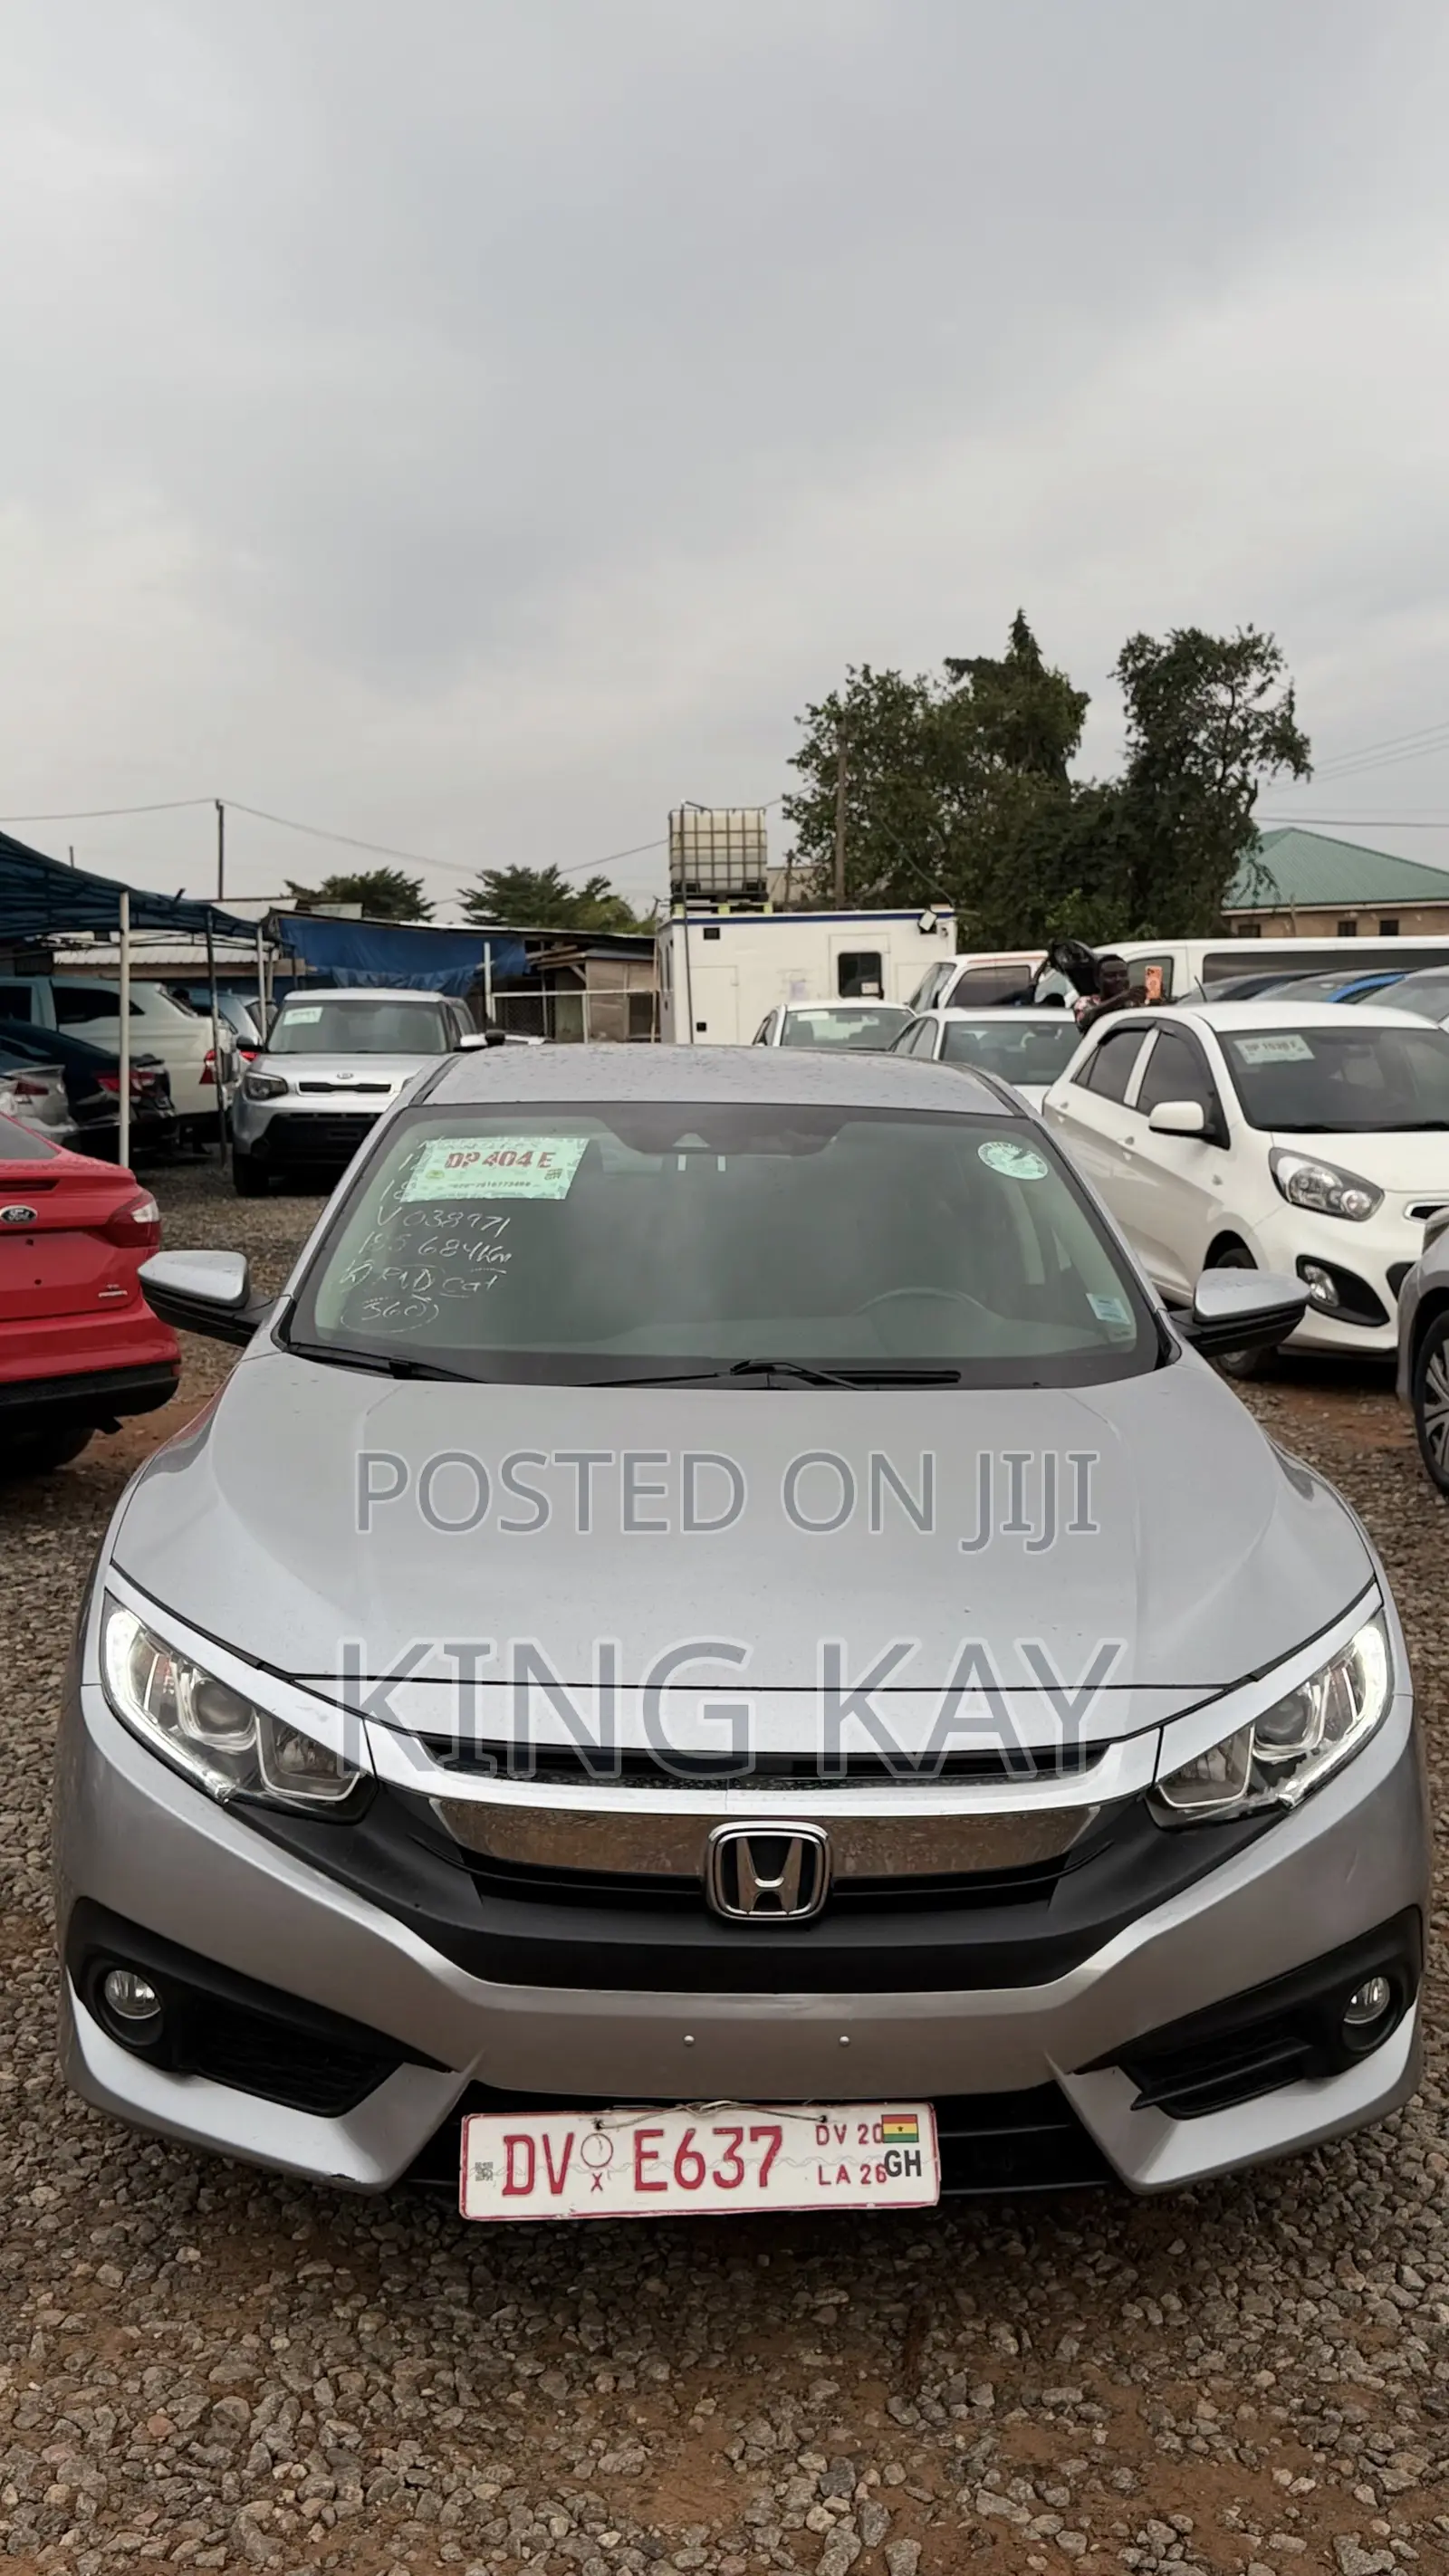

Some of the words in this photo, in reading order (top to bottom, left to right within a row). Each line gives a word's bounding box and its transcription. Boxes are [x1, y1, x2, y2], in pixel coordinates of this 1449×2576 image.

[445, 1151, 481, 1169] DP
[482, 1151, 534, 1167] 404
[537, 1152, 556, 1169] E
[816, 2123, 848, 2146] DV
[502, 2132, 575, 2197] DV
[634, 2125, 782, 2192] E637
[884, 2150, 922, 2178] GH
[819, 2164, 851, 2185] LA
[860, 2163, 888, 2185] 26
